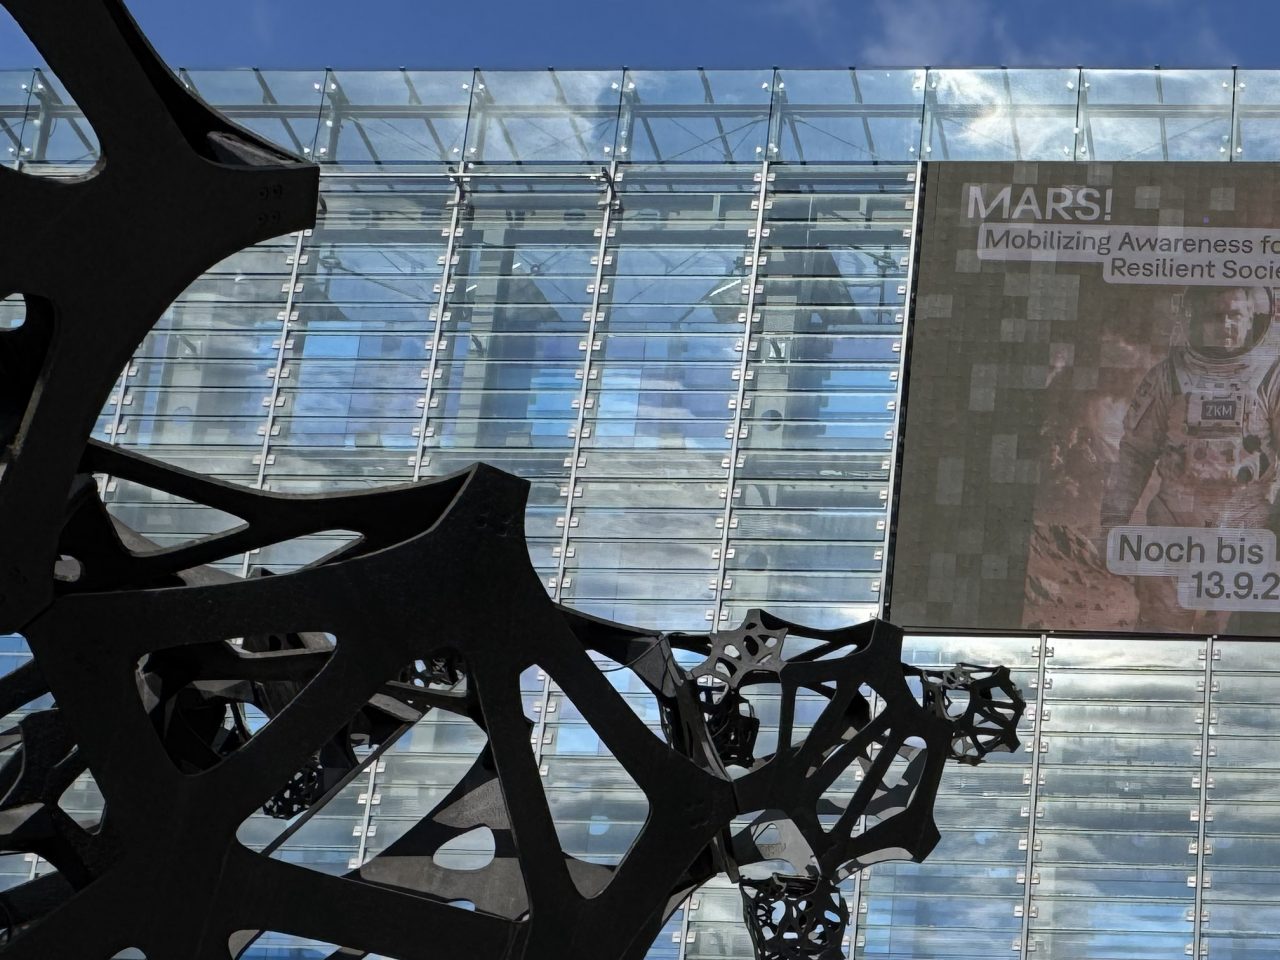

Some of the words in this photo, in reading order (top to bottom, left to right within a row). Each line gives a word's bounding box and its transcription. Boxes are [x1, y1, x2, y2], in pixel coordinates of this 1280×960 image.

[968, 186, 1112, 221] MARS!
[985, 229, 1111, 255] Mobilizing
[1118, 232, 1253, 254] Awareness
[1111, 258, 1216, 279] Resilient
[1206, 404, 1232, 417] ZKM
[1119, 534, 1205, 563] Noch
[1217, 537, 1264, 565] bis
